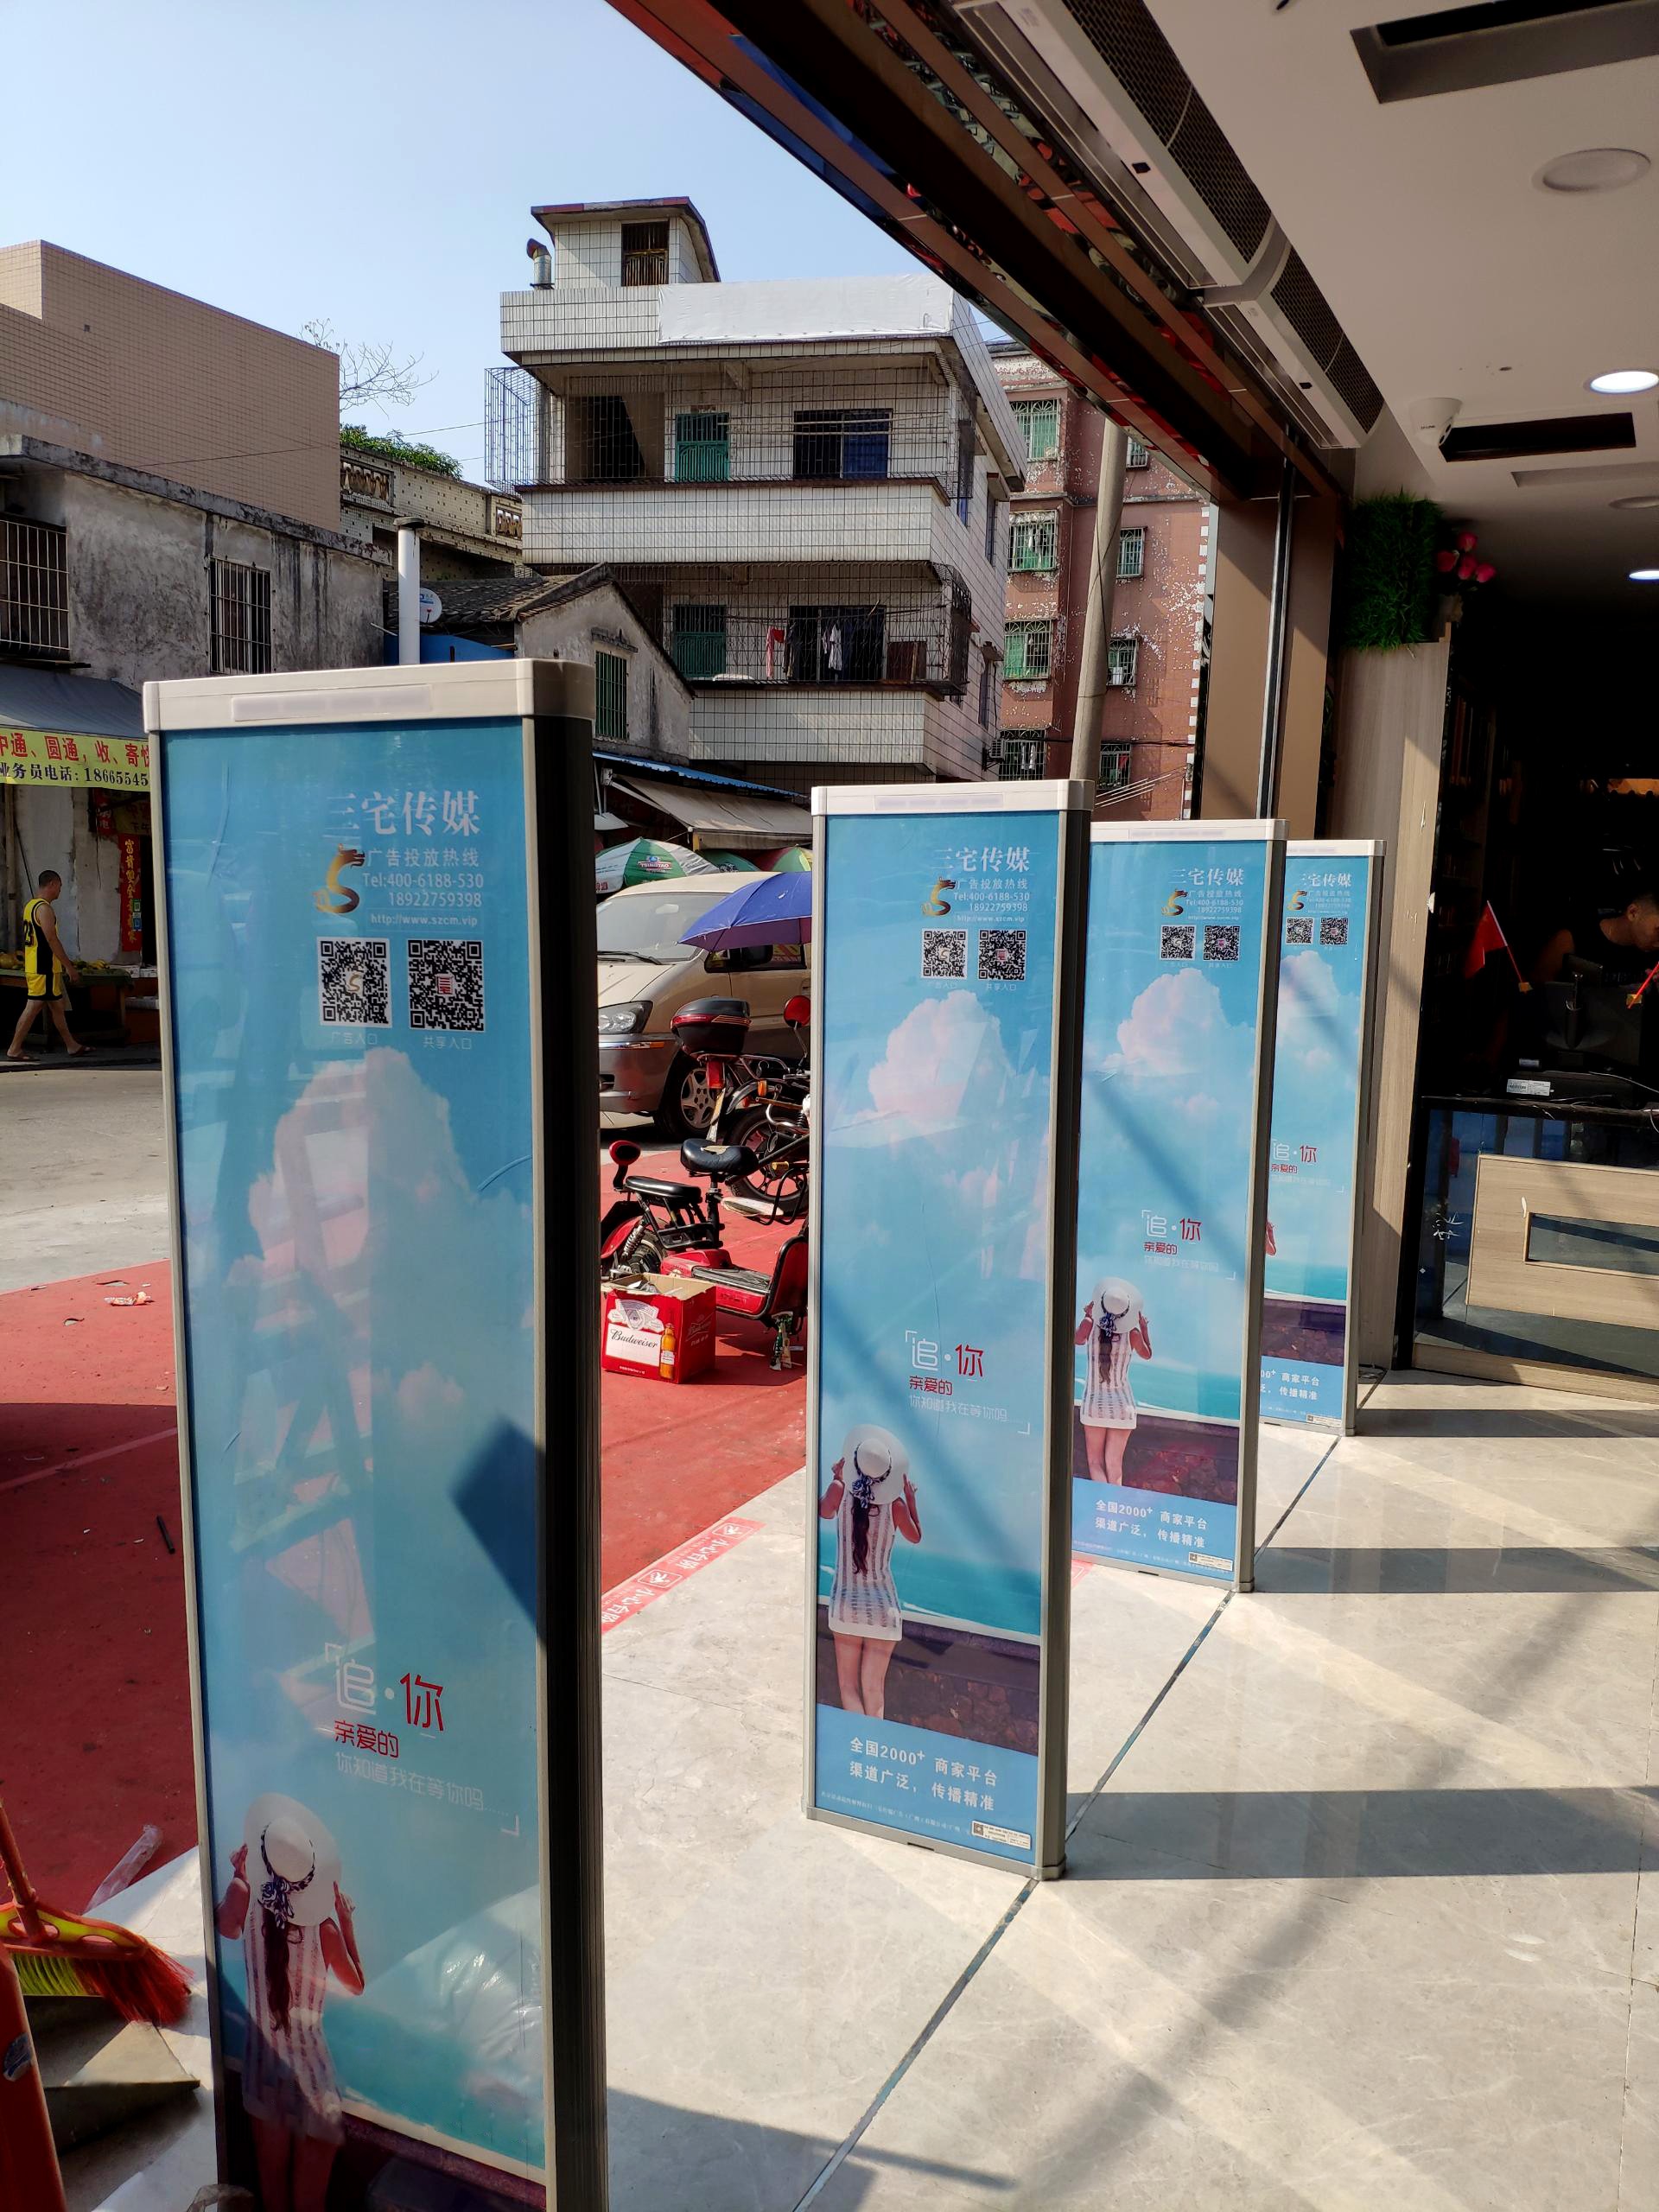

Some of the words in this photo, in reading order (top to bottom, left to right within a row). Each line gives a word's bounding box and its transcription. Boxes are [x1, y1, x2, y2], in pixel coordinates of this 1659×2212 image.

[324, 790, 480, 837] 三宅传媒
[366, 848, 480, 868] 广告投放热线
[932, 846, 1031, 873] 三宅传媒
[363, 873, 484, 888] Tel:400-6188-530
[957, 878, 1028, 891] 广告投放热线
[1168, 868, 1244, 886] 三宅传媒
[1300, 873, 1352, 887] 三宅传媒
[390, 892, 482, 907] 18922759398
[954, 893, 1030, 901] Tel:400-6188-530
[969, 903, 1028, 912] 18922759398
[371, 913, 478, 927] http://www.szcm.vip
[423, 1036, 472, 1050] 共享入口
[1144, 1241, 1178, 1255] 亲爱的
[610, 1328, 659, 1349] Budweiser
[909, 1375, 953, 1396] 亲爱的
[1160, 1510, 1208, 1530] 商家平台
[1157, 1529, 1206, 1548] 传播精准
[675, 1538, 730, 1570] 小心台阶
[334, 1719, 399, 1758] 亲爱的
[933, 1758, 998, 1788] 商家平台
[931, 1783, 995, 1812] 传播精准
